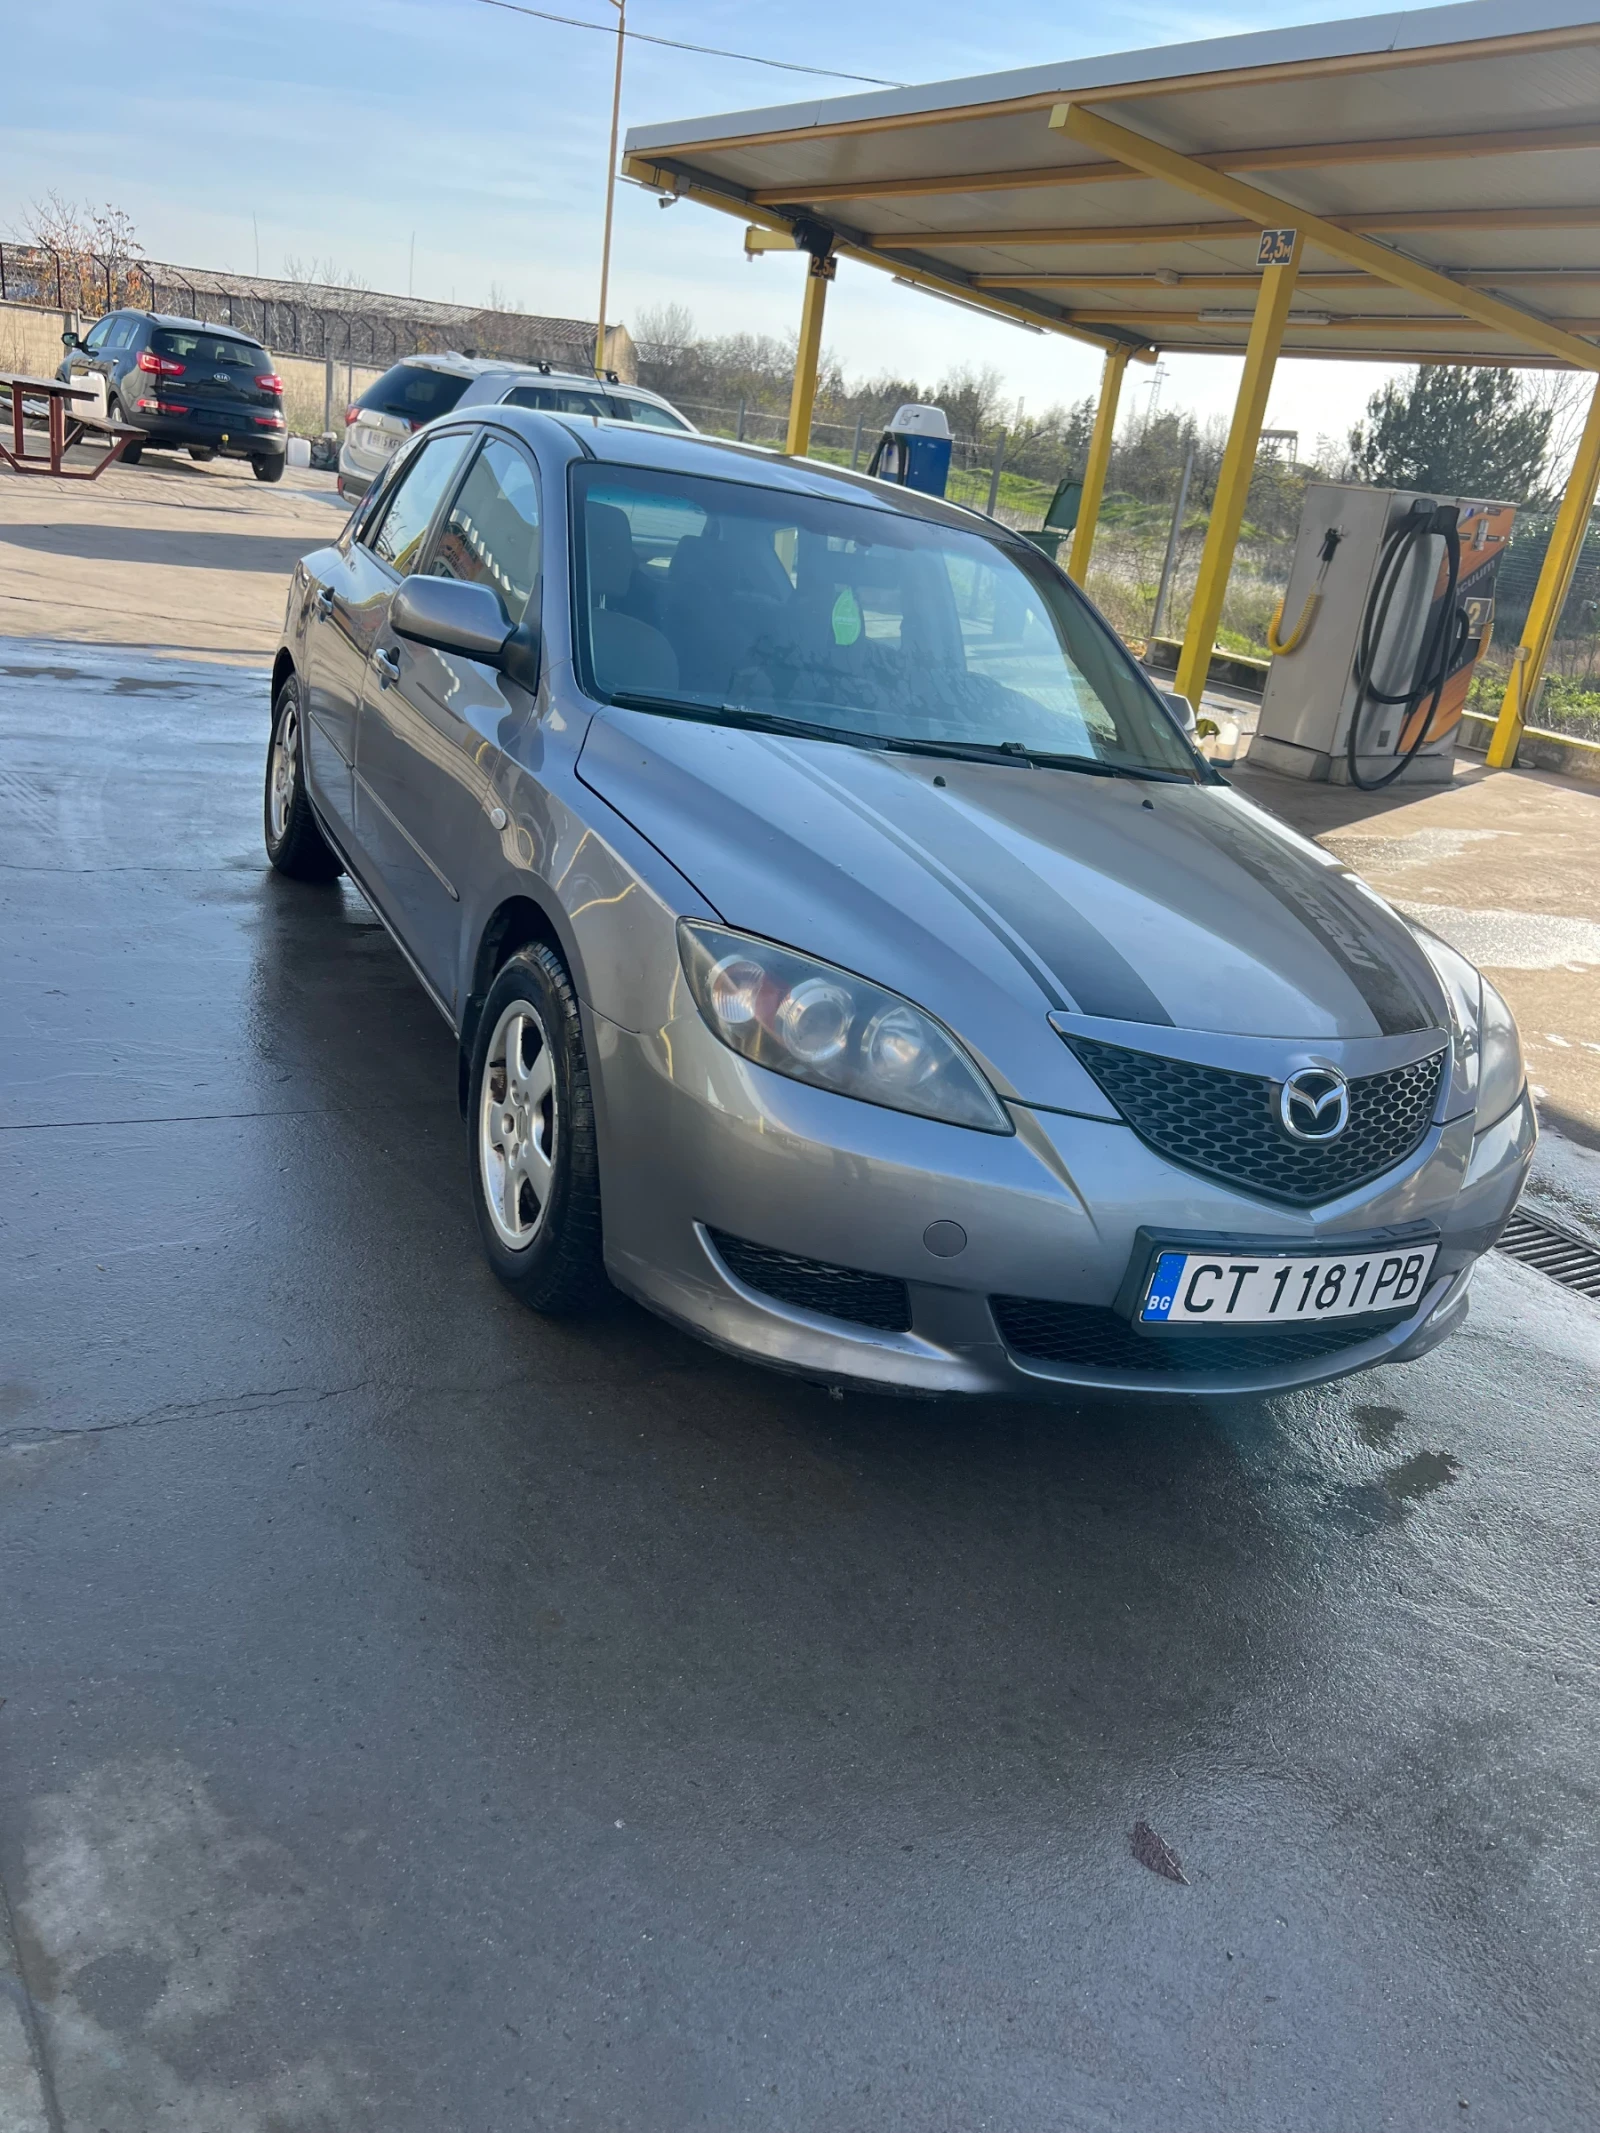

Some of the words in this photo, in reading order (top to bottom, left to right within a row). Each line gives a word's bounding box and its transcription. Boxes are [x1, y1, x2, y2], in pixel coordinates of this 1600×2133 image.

[1466, 602, 1481, 634] 2
[1147, 1295, 1171, 1311] BG
[1183, 1264, 1258, 1313] CT
